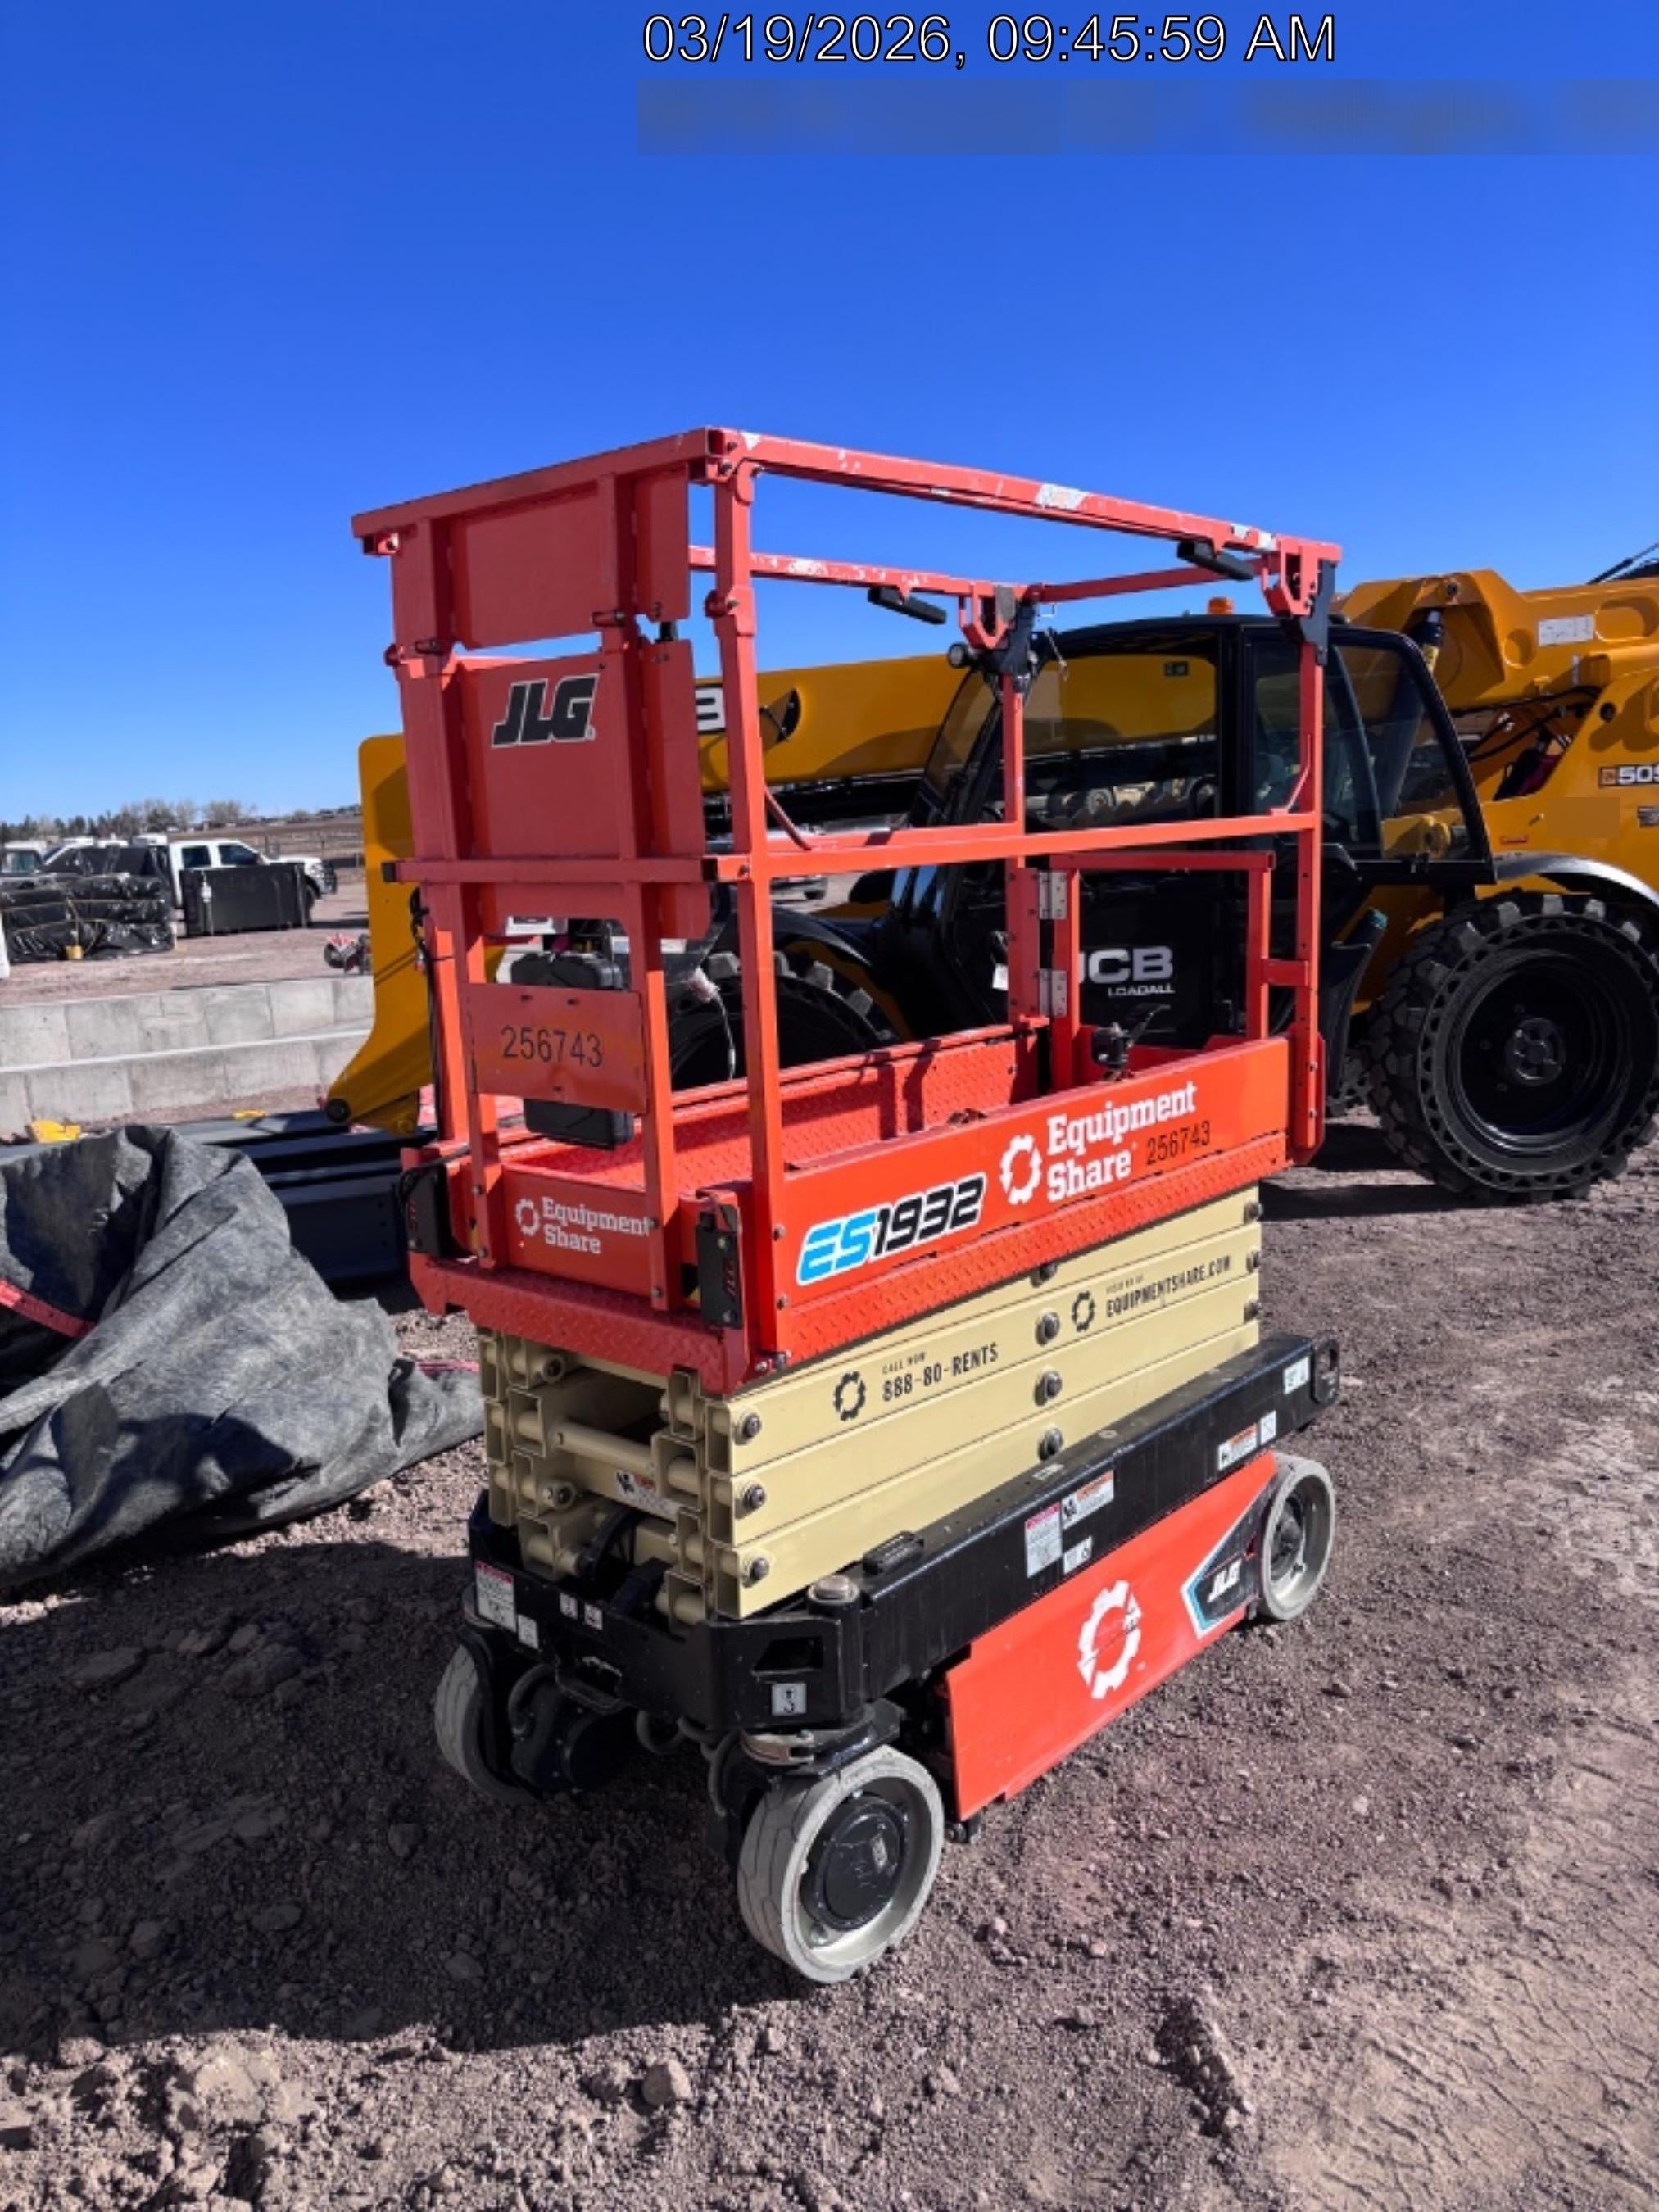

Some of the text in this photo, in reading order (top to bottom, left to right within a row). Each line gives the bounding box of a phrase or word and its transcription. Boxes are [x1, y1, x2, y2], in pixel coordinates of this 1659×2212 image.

[492, 674, 599, 747] JLG
[1108, 983, 1176, 998] LOADALL
[501, 1025, 603, 1067] 256743
[1047, 1081, 1196, 1156] Equipment
[1146, 1120, 1211, 1165] 256743
[1047, 1149, 1131, 1202] Share
[544, 1223, 601, 1255] Share
[797, 1172, 987, 1286] ES1932
[882, 1342, 999, 1402] 888-80-RENTS
